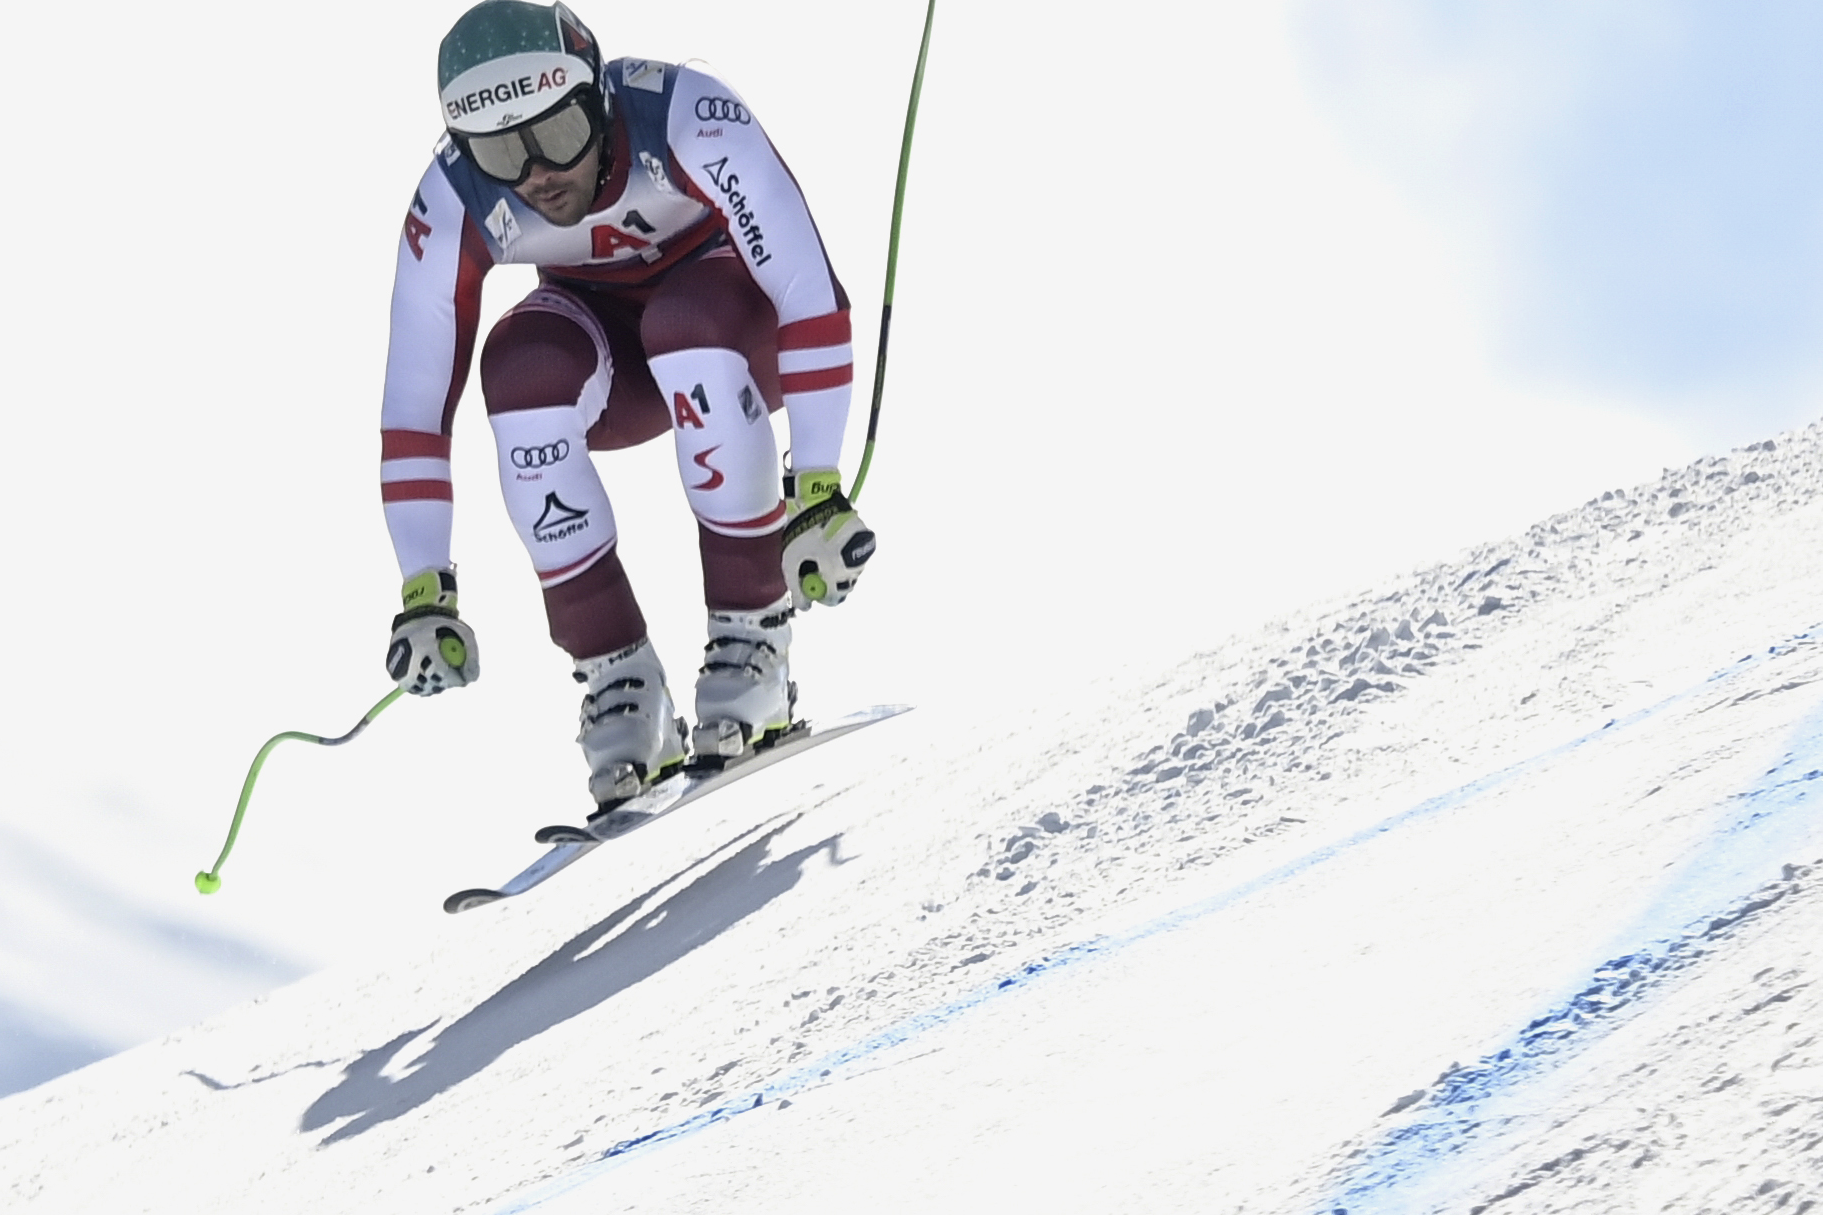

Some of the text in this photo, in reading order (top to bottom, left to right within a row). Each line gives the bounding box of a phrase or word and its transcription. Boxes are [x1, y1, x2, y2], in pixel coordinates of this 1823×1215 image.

[446, 67, 566, 120] ENERGIE AG
[697, 128, 723, 138] Audi
[591, 209, 656, 259] A1
[720, 174, 772, 267] Schöffel
[674, 383, 710, 430] A1
